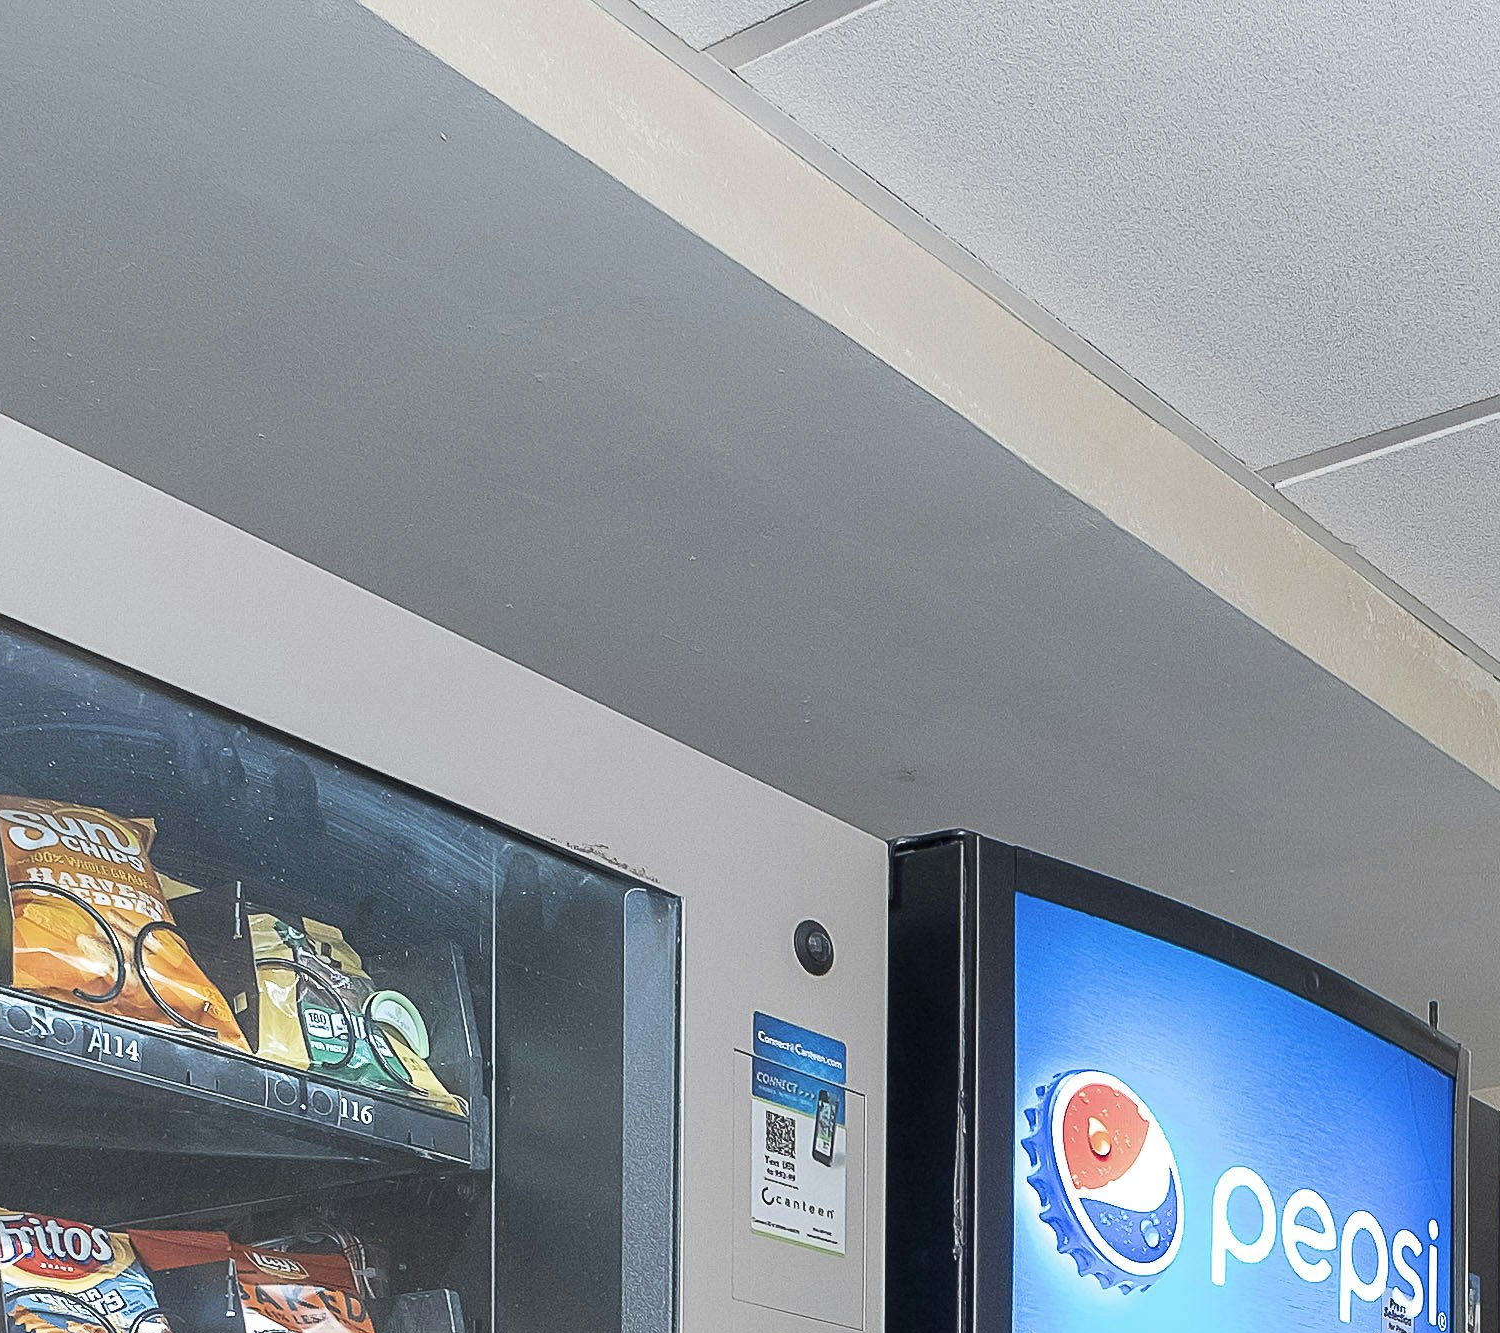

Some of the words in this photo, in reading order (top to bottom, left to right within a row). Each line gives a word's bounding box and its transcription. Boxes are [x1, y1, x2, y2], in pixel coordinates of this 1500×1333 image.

[60, 834, 146, 873] CHIPS
[339, 1097, 375, 1125] 116
[775, 1193, 834, 1219] canteen
[1211, 1165, 1441, 1327] pepsi
